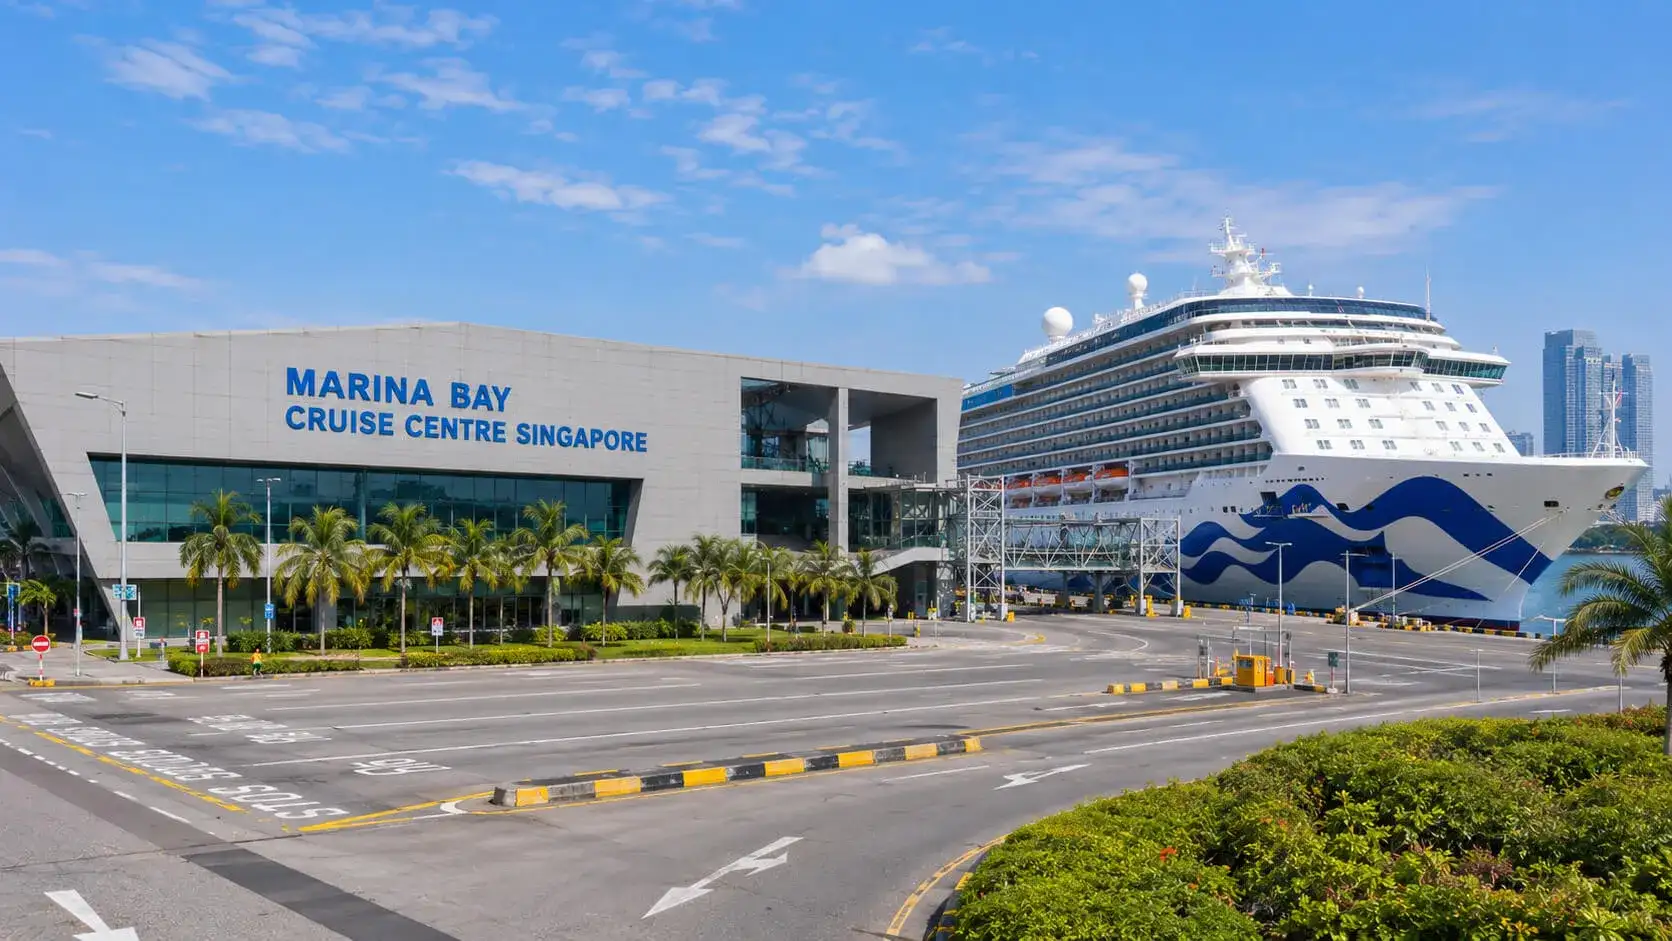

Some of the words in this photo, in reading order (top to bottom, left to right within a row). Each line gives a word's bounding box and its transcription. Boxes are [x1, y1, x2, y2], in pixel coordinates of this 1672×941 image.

[286, 366, 434, 407] MARINA
[451, 381, 512, 412] BAY
[285, 405, 395, 436] CRUISE
[404, 414, 507, 443] CENTRE
[516, 422, 648, 453] SINGAPORE
